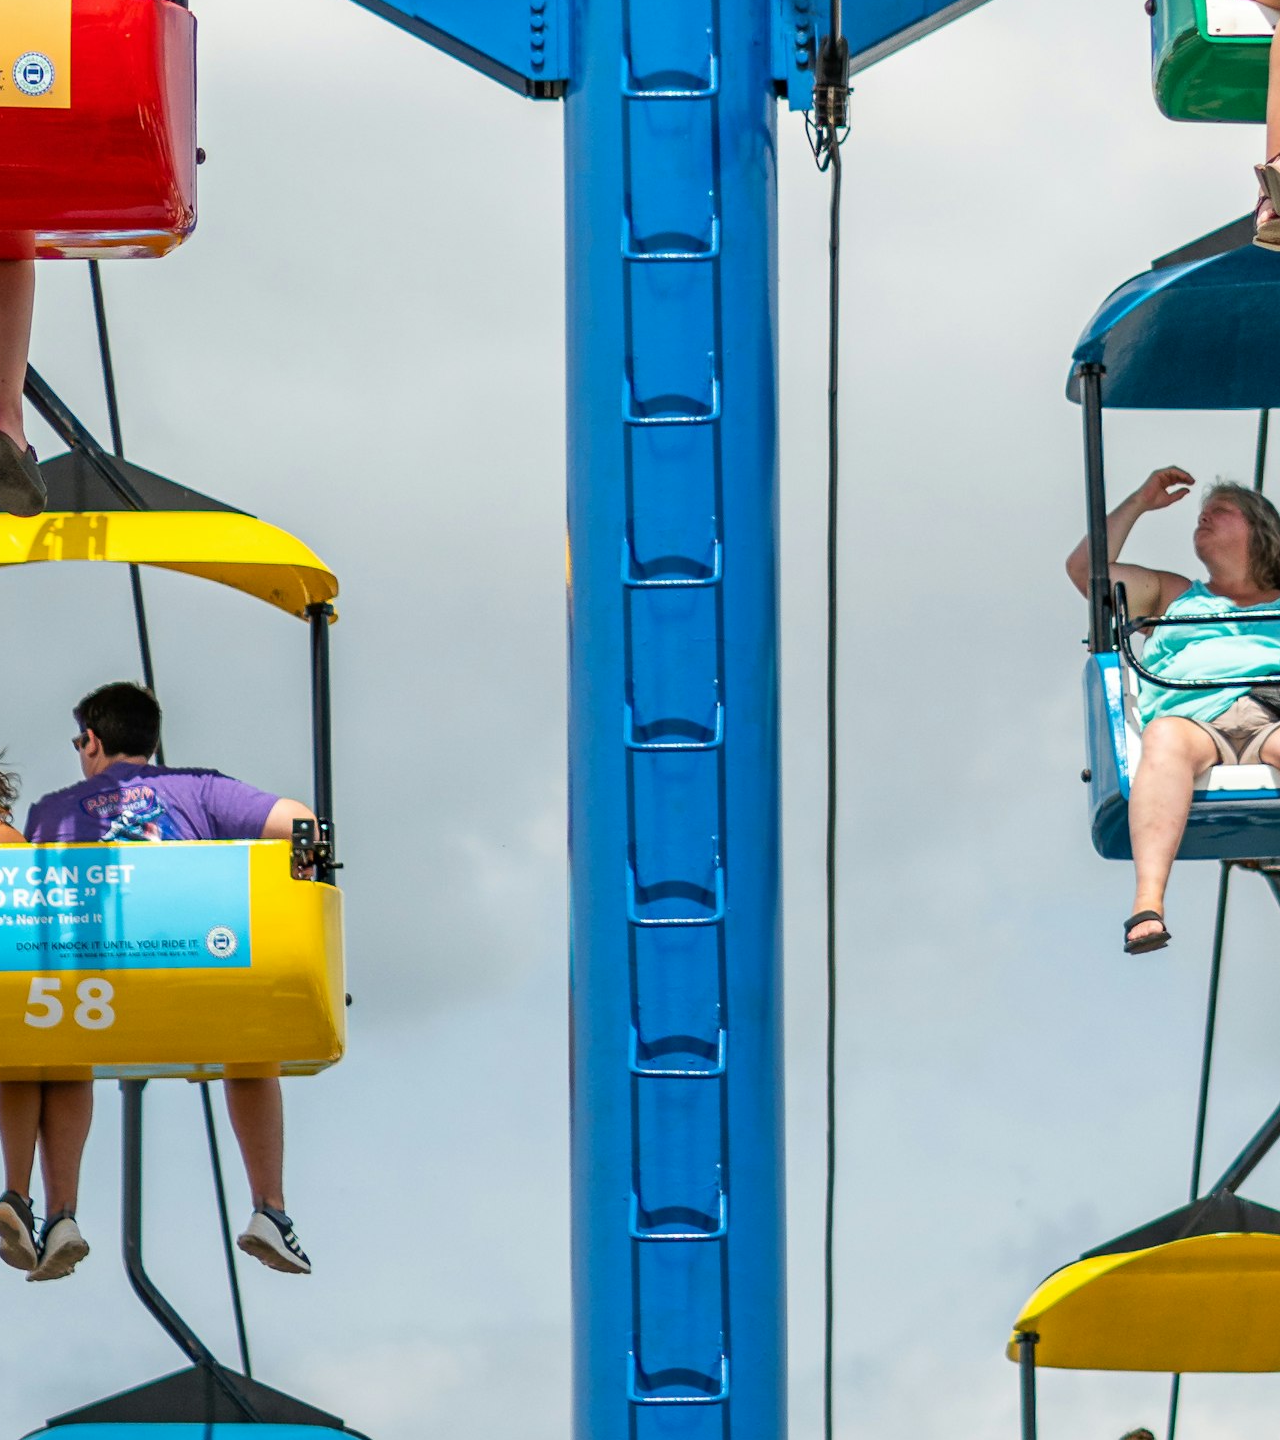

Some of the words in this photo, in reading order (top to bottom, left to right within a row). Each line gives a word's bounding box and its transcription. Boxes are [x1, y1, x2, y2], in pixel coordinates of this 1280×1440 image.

[25, 866, 81, 885] CAN
[86, 865, 135, 885] GET
[13, 888, 97, 908] RACE.”
[16, 914, 55, 925] Never
[58, 913, 89, 925] Tried
[92, 913, 102, 924] It
[24, 977, 116, 1031] 58
